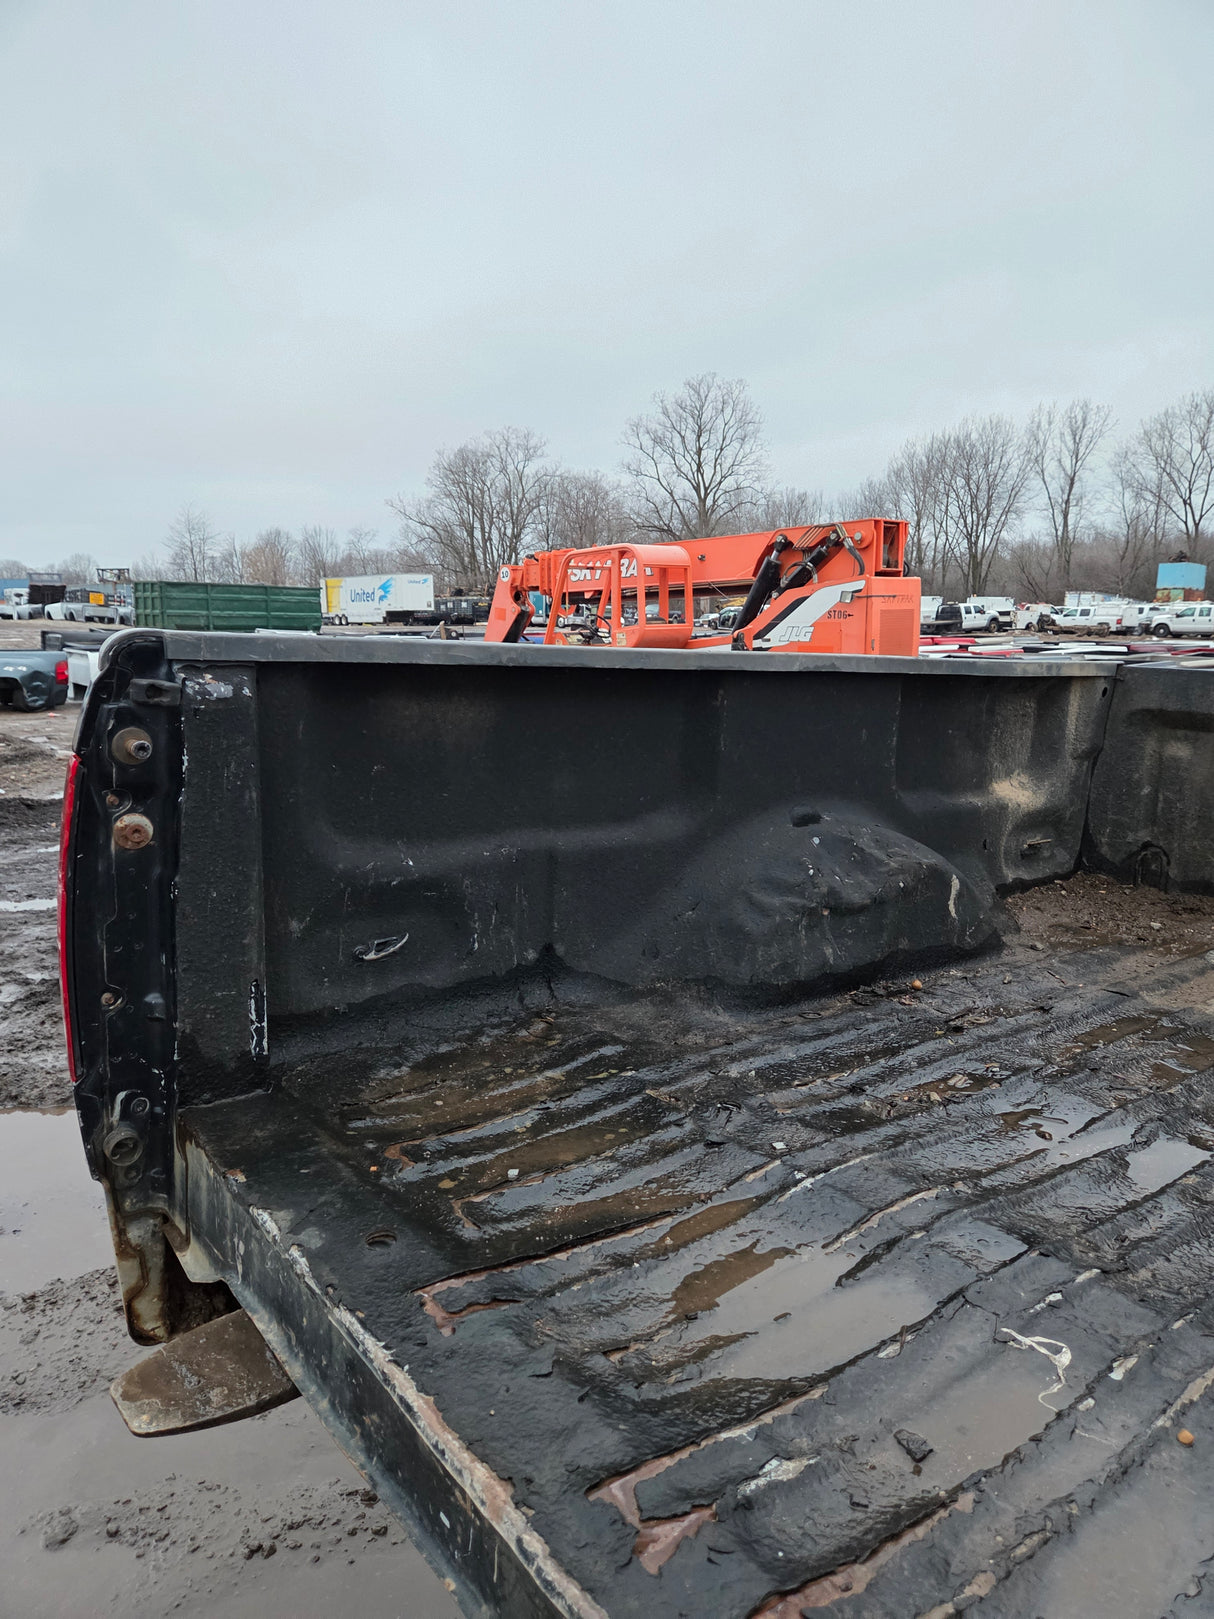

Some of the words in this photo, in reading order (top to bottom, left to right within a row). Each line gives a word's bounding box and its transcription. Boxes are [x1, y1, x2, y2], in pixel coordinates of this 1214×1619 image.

[501, 570, 508, 578] 10
[350, 588, 375, 602] United
[827, 610, 848, 619] ST06
[779, 626, 814, 642] JLG
